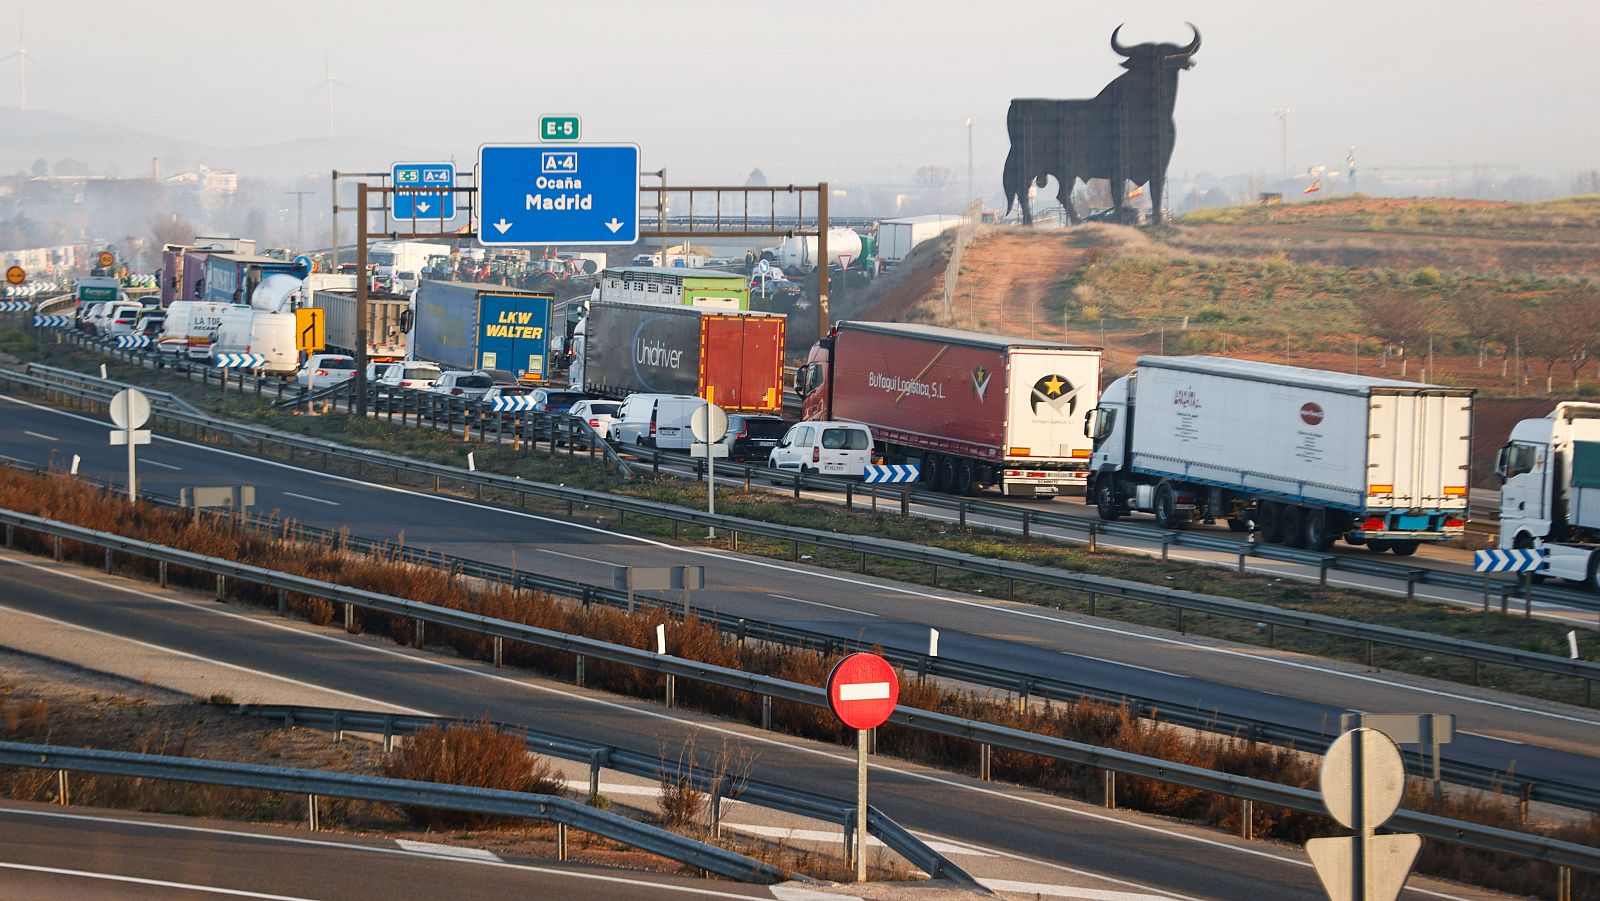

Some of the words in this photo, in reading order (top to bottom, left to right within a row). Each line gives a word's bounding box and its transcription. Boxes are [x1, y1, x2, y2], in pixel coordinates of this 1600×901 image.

[546, 121, 573, 135] E-5
[545, 156, 574, 170] A-4
[398, 171, 418, 181] E-5
[426, 171, 447, 181] A-4
[535, 176, 582, 189] Ocaña
[525, 193, 593, 211] Madrid
[194, 317, 205, 325] LA
[498, 311, 533, 325] LKW
[486, 324, 544, 340] WALTER
[636, 337, 684, 369] Unidriver
[868, 371, 898, 393] BuYagui
[931, 381, 946, 399] S.L.
